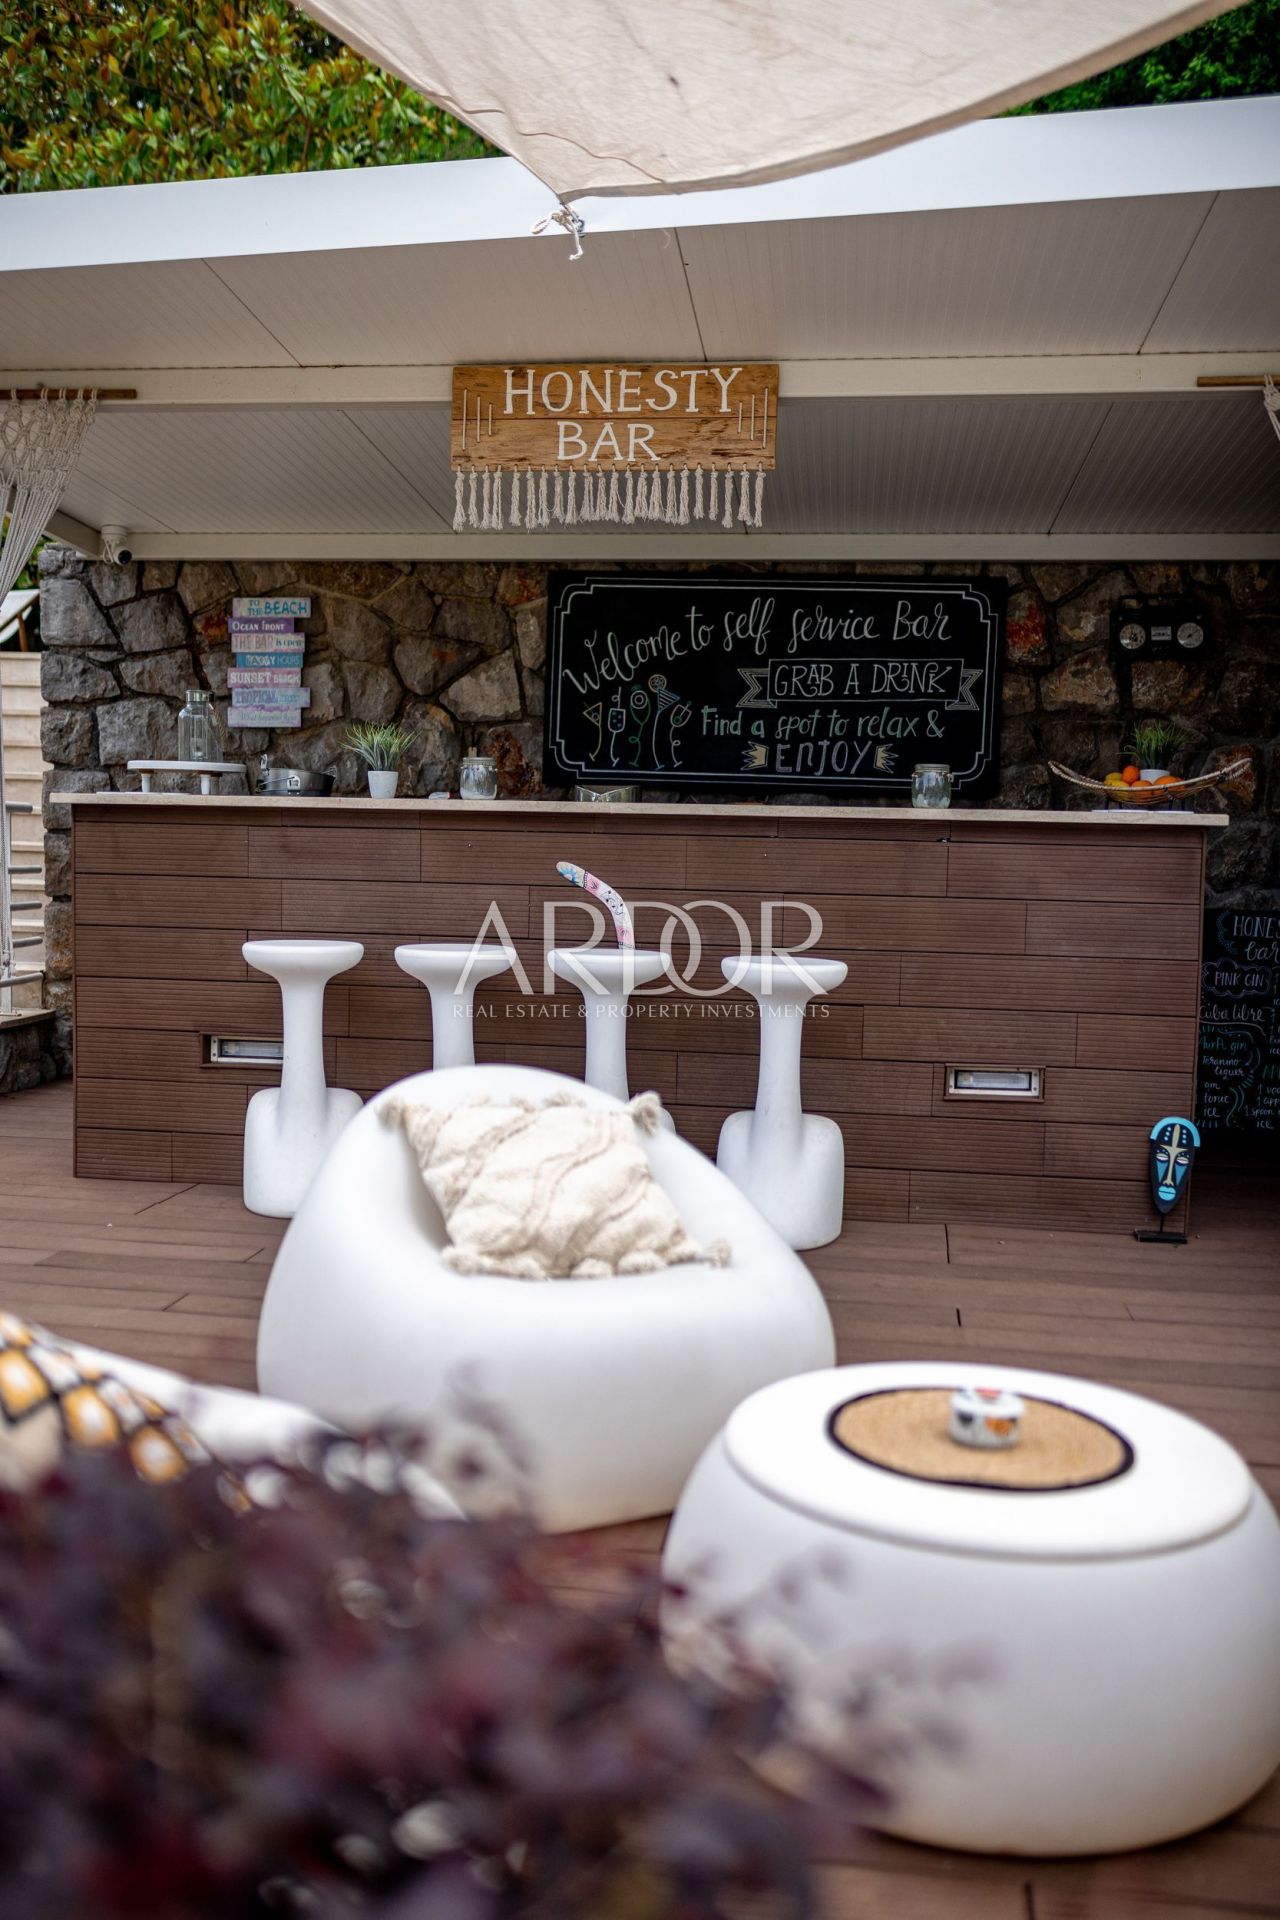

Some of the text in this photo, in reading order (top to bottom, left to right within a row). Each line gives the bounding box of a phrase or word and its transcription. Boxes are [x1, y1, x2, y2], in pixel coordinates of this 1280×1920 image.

[503, 367, 743, 415] HONESTY
[556, 421, 662, 462] BAR
[264, 601, 308, 615] BEACH
[233, 634, 255, 650] THE
[256, 634, 275, 650] BAR
[562, 597, 952, 695] Welcome to self service Bar
[230, 671, 272, 685] SUNSET
[774, 662, 954, 697] GRAB A DRINK
[234, 689, 278, 704] TROPICAL
[701, 705, 946, 738] Find a spot to relax &
[1232, 914, 1280, 938] HONE
[1215, 971, 1264, 986] PINK GIN
